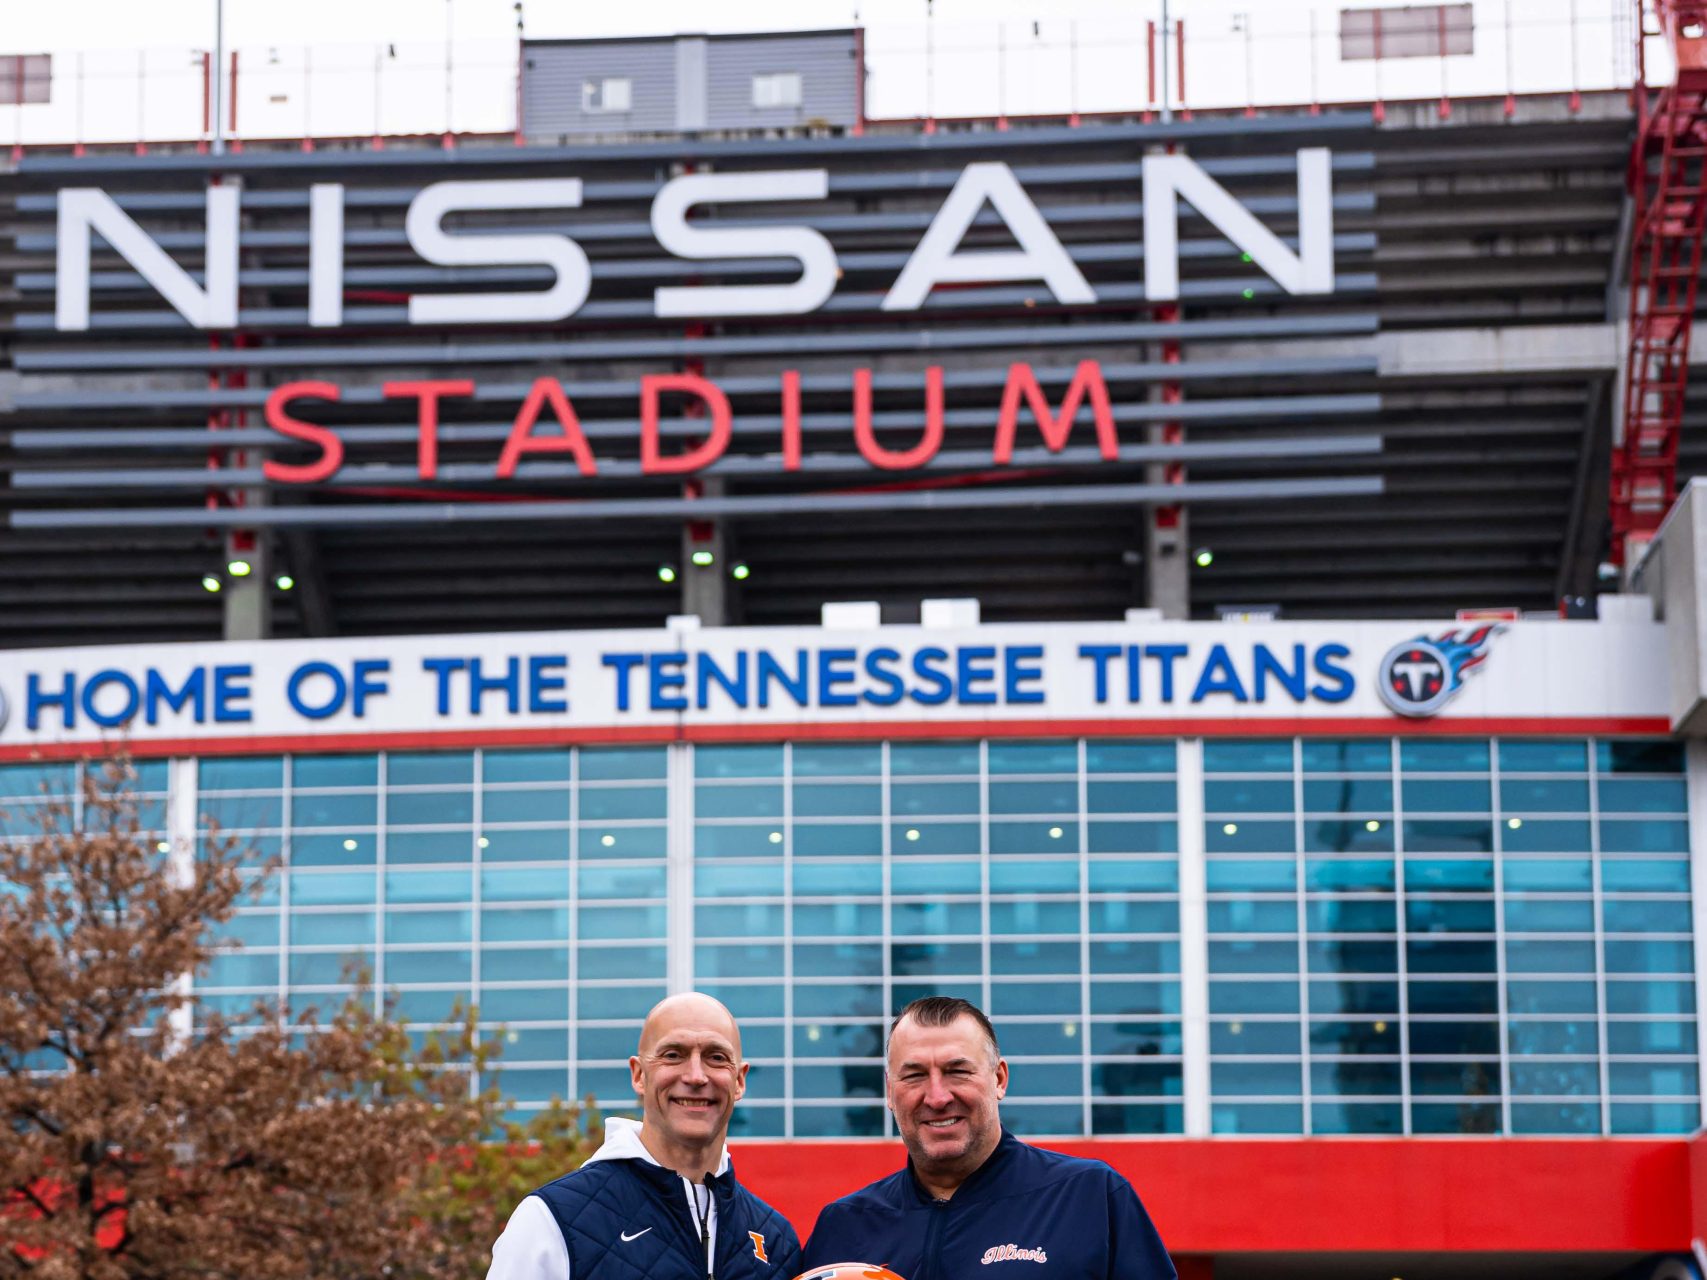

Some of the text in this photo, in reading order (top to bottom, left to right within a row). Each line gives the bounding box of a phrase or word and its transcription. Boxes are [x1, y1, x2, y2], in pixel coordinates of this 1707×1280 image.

[56, 148, 1334, 330] NISSAN
[262, 360, 1120, 482] STADIUM
[26, 643, 1356, 731] HOME OF THE TENNESSEE TITANS
[981, 1243, 1048, 1265] Illinois
